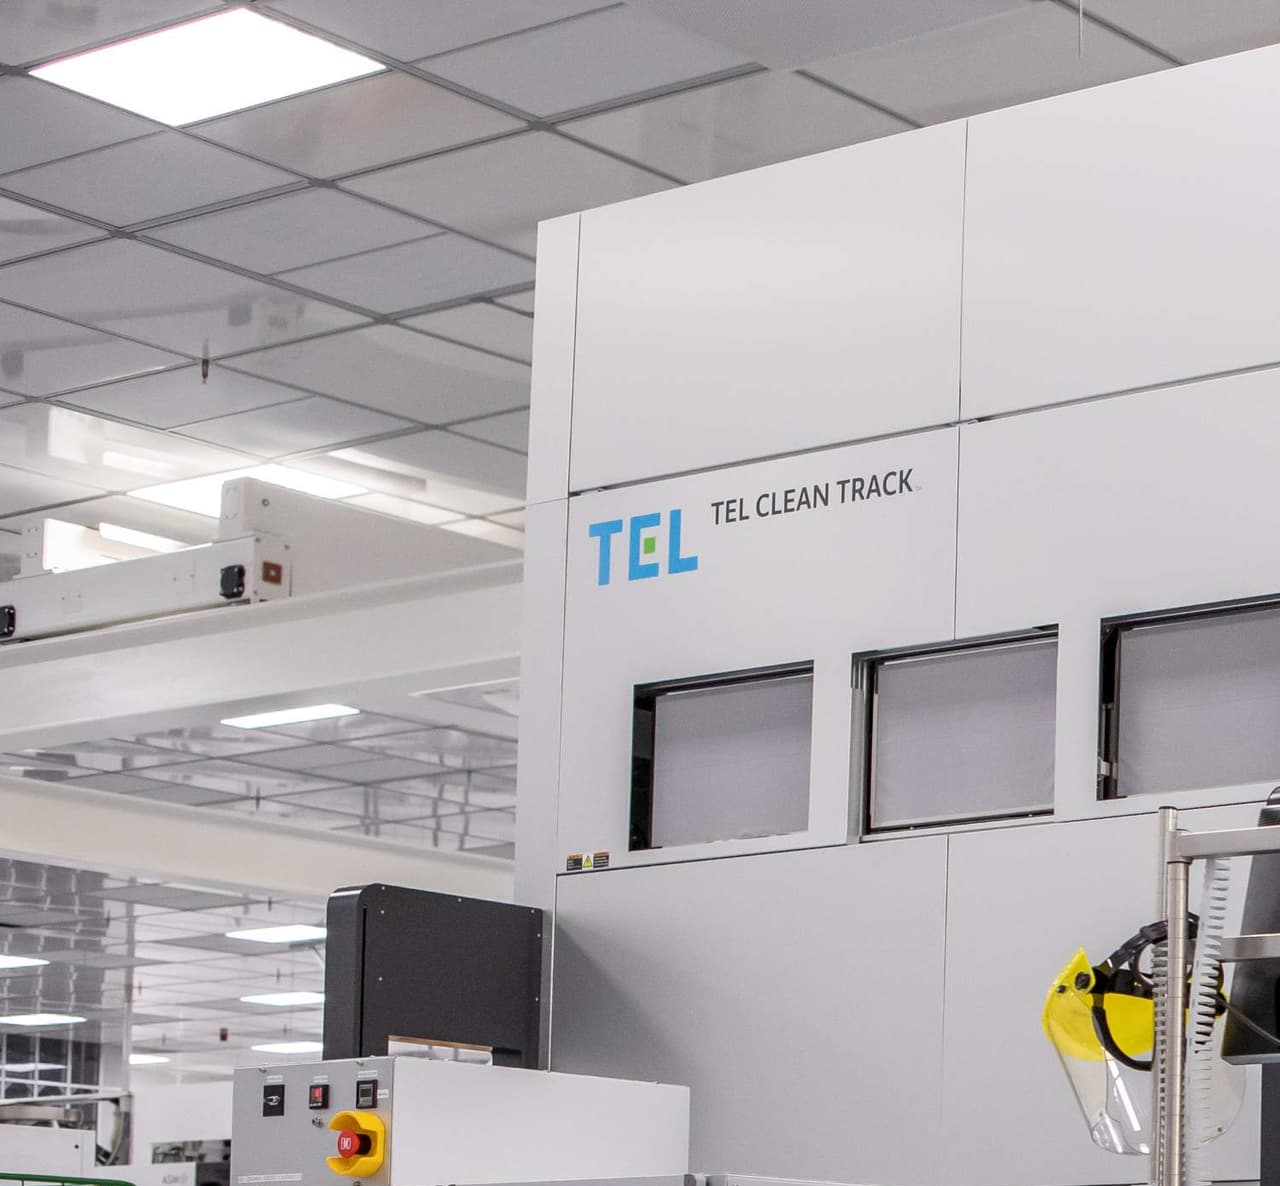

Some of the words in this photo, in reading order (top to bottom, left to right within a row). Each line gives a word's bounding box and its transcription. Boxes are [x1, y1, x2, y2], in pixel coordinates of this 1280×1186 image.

[711, 497, 750, 525] TEL
[755, 483, 830, 518] CLEAN
[836, 468, 914, 504] TRACK
[588, 508, 698, 586] TEL
